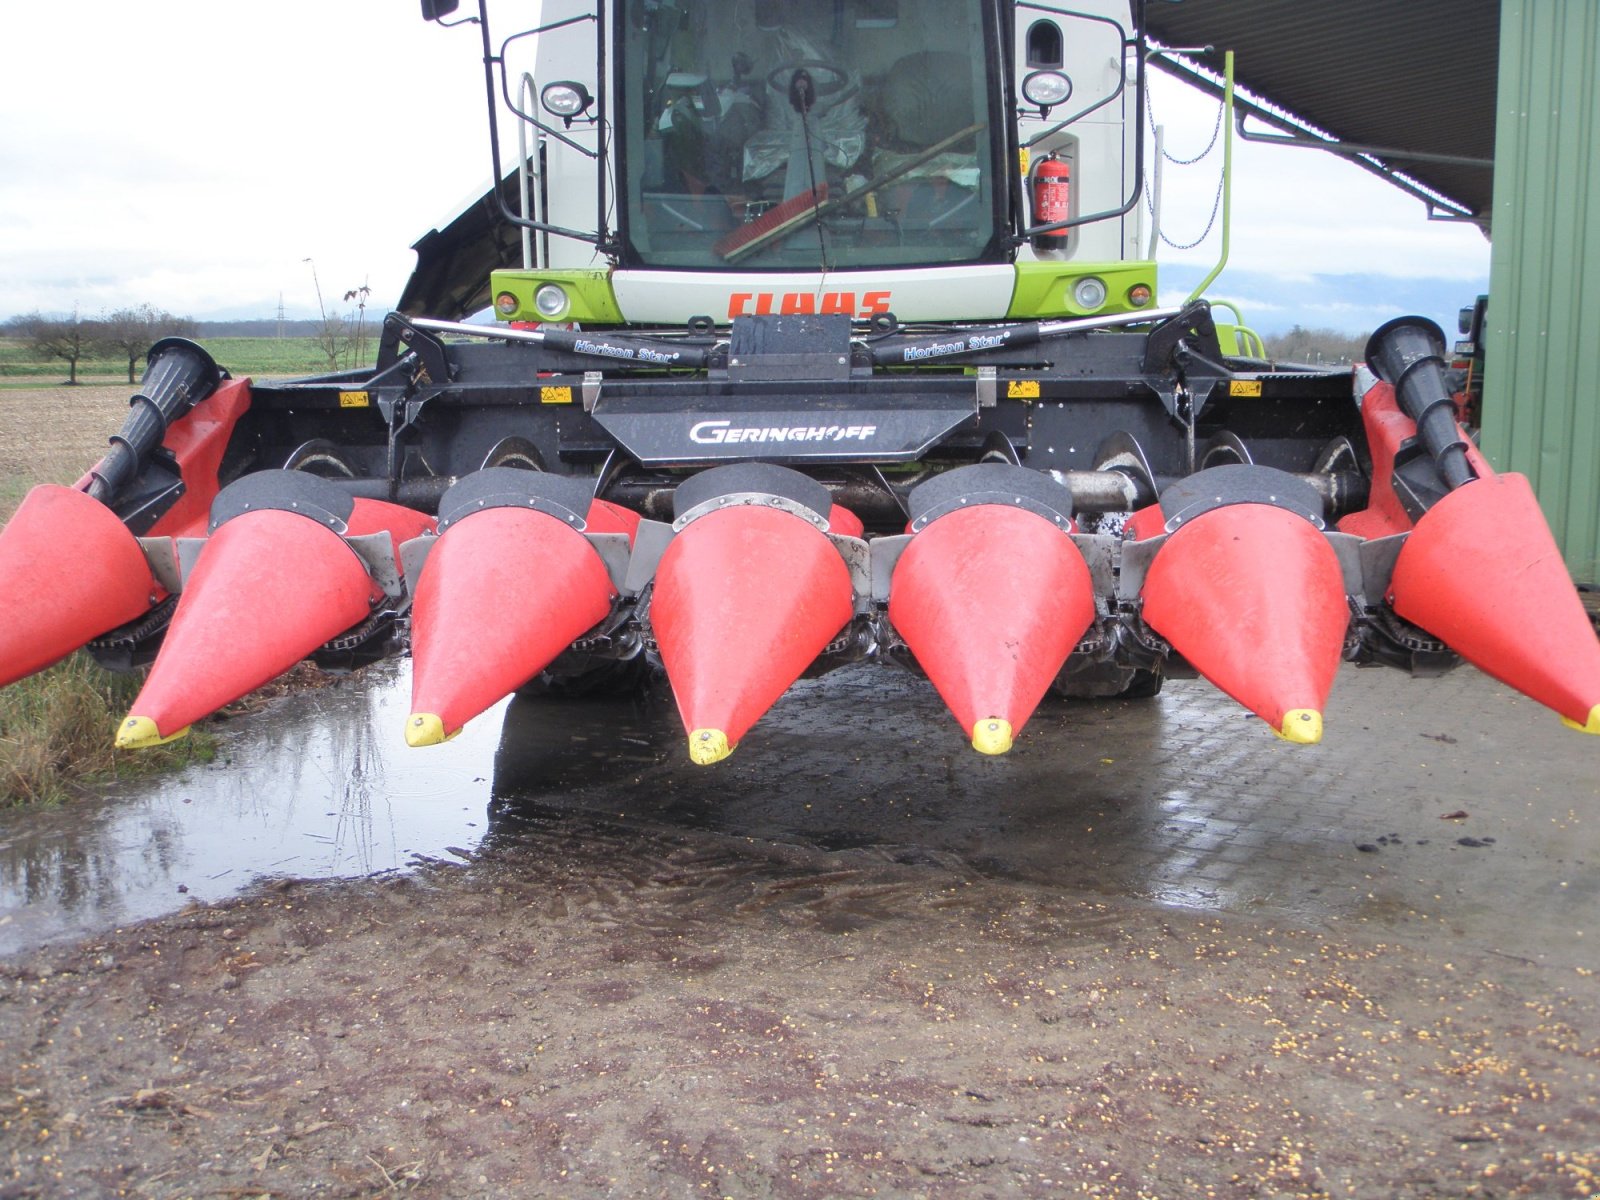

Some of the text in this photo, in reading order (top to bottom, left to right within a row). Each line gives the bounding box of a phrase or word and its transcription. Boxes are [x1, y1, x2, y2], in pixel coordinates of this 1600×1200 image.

[728, 291, 892, 319] CLAAS
[575, 340, 634, 358] Horizon
[904, 341, 965, 360] Horizon
[689, 420, 877, 444] GERINGHOFF
